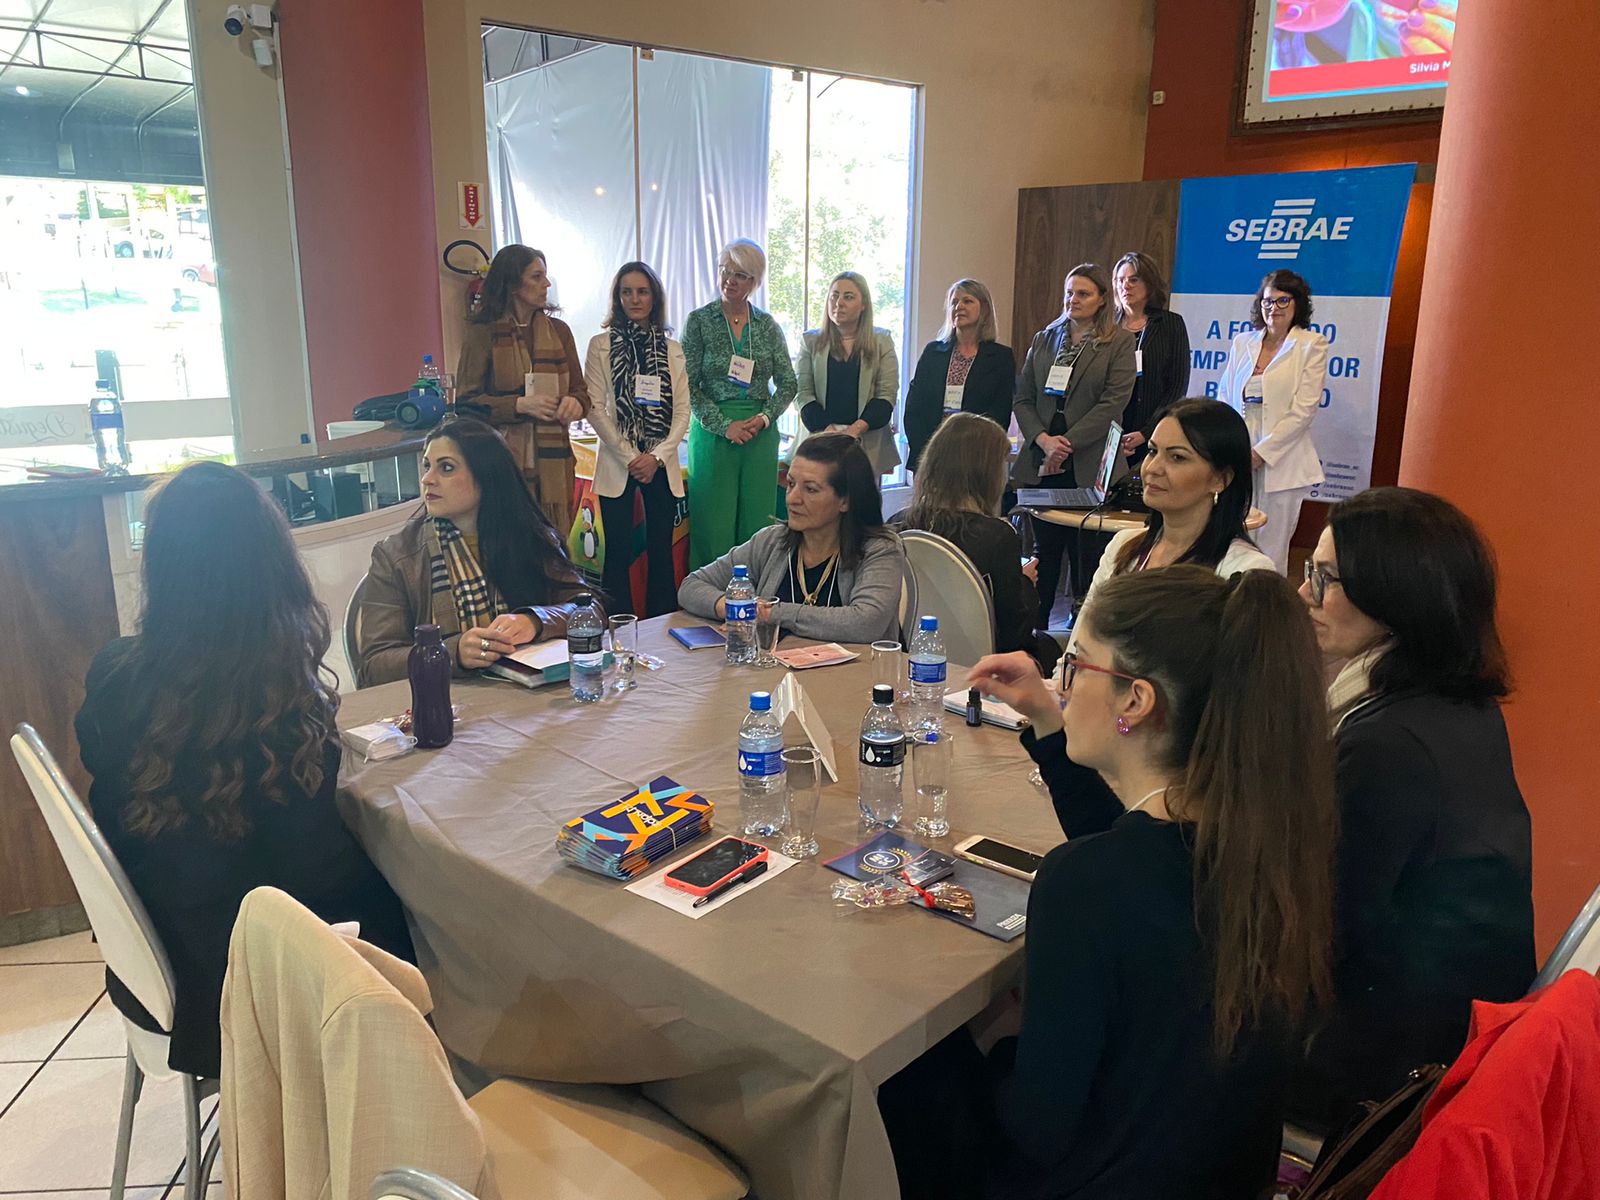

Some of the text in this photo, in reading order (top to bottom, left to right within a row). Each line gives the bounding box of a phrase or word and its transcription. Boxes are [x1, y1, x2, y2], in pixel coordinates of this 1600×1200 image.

[1409, 60, 1451, 74] Silvia M
[1225, 216, 1354, 242] SEBRAE
[1206, 320, 1221, 340] A
